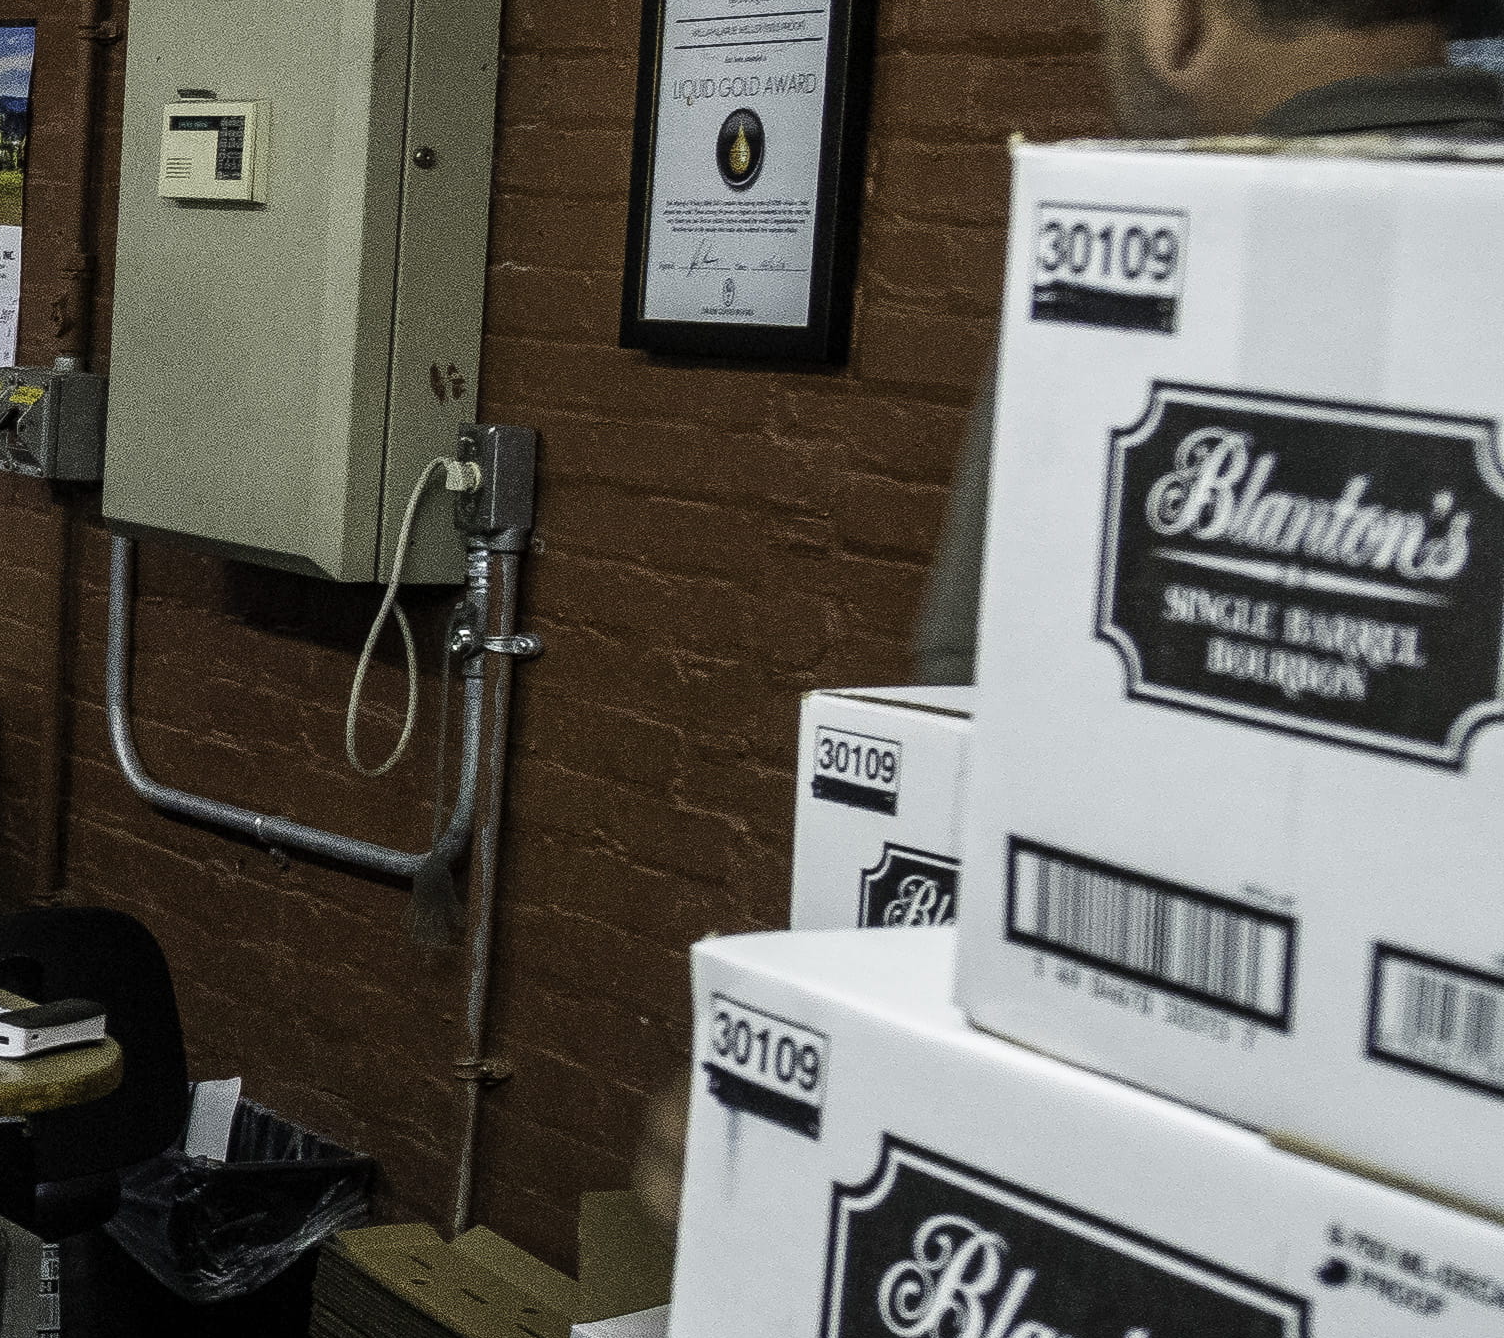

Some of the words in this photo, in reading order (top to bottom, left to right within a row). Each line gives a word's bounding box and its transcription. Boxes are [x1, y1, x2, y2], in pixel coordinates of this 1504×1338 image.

[673, 79, 715, 99] LIQUID
[719, 75, 758, 98] GOLD
[763, 73, 816, 94] AWARD
[3, 251, 15, 260] INC.
[1038, 221, 1180, 281] 30109
[1144, 425, 1472, 582] Blanton's
[1161, 583, 1274, 637] SINGLE
[1281, 608, 1425, 668] BARREL
[1205, 635, 1370, 699] BOURBON
[818, 735, 897, 785] 30109
[710, 1009, 823, 1094] 30109
